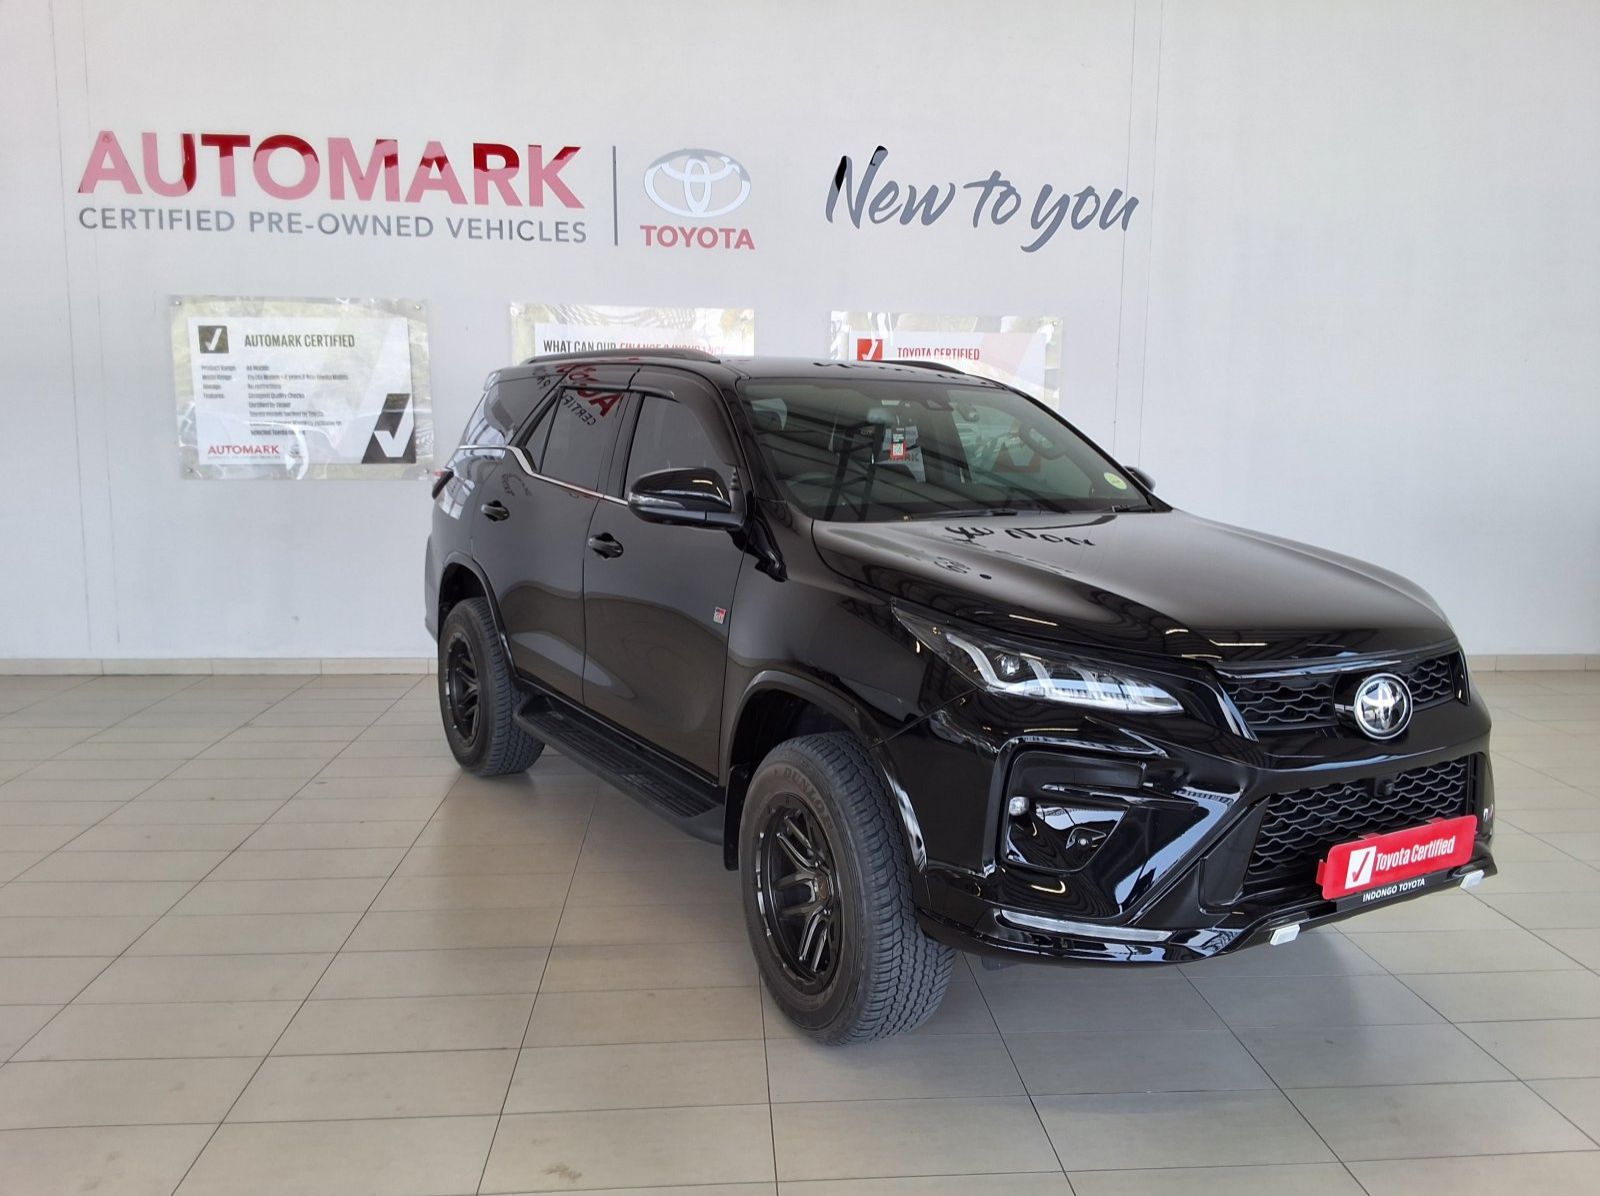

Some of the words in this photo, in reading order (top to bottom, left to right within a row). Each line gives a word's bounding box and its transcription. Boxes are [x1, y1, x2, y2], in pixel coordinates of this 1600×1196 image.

[77, 130, 585, 208] AUTOMARK
[825, 145, 956, 229] New
[963, 169, 1022, 228] to
[1020, 183, 1140, 254] you
[78, 206, 235, 233] CERTIFIED
[248, 210, 435, 239] PRE-OWNED
[445, 216, 588, 245] VEHICLES
[639, 224, 756, 251] TOYOTA
[244, 334, 302, 348] AUTOMARK
[304, 334, 356, 348] CERTIFIED
[543, 340, 571, 353] WHAT
[574, 340, 594, 353] CAN
[897, 347, 932, 359] TOYOTA
[934, 347, 980, 361] CERTIFIED
[208, 445, 280, 455] AUTOMARK
[1375, 848, 1410, 871] Toyota
[1411, 836, 1456, 862] Certified
[1362, 885, 1398, 902] INDONGO
[1399, 878, 1426, 893] TOYOTA
